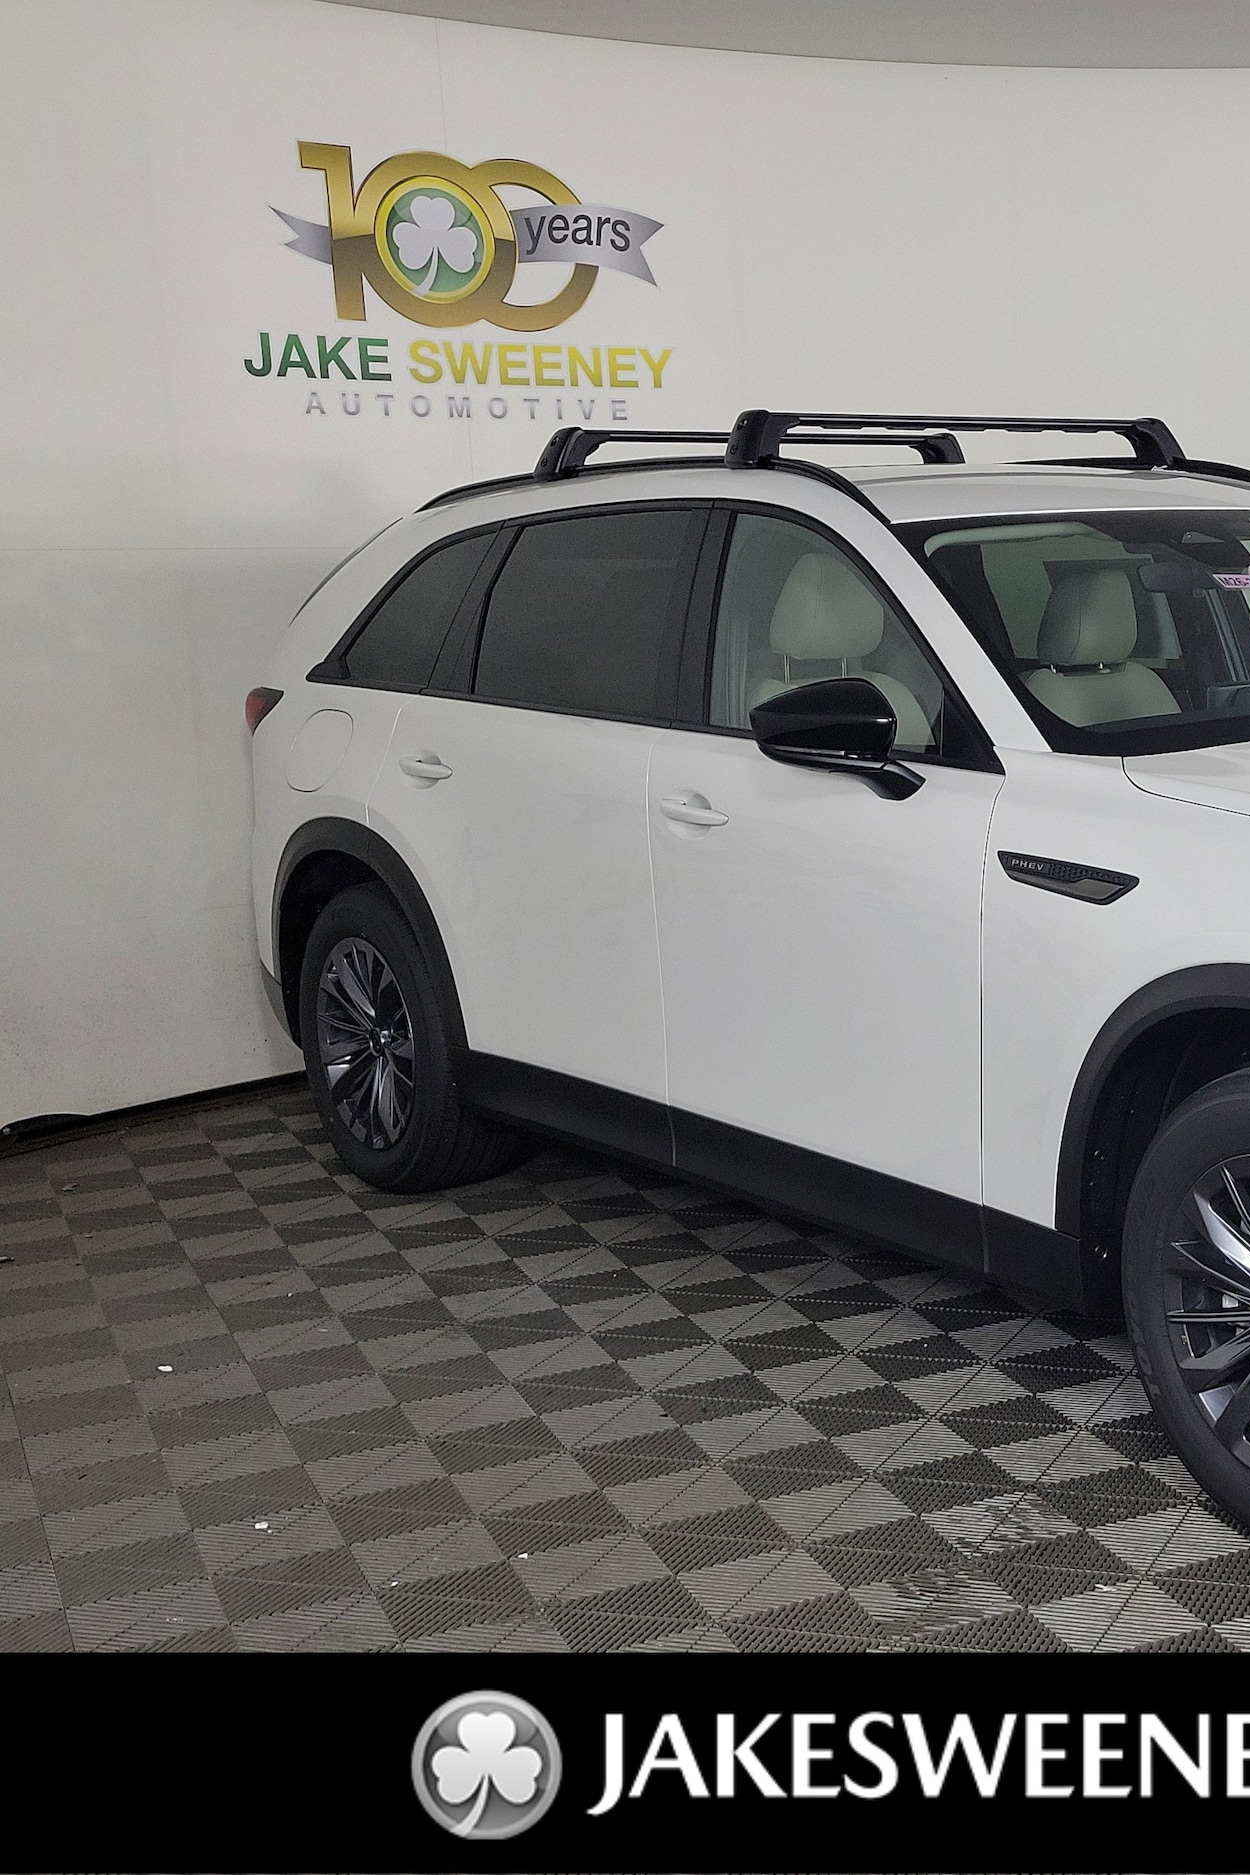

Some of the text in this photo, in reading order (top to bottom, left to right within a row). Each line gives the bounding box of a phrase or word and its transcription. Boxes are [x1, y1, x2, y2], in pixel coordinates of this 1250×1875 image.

[297, 140, 631, 332] 100 years
[244, 332, 673, 389] JAKE SWEENEY
[305, 391, 628, 421] AUTOMOTIVE
[1011, 858, 1045, 871] PHEV
